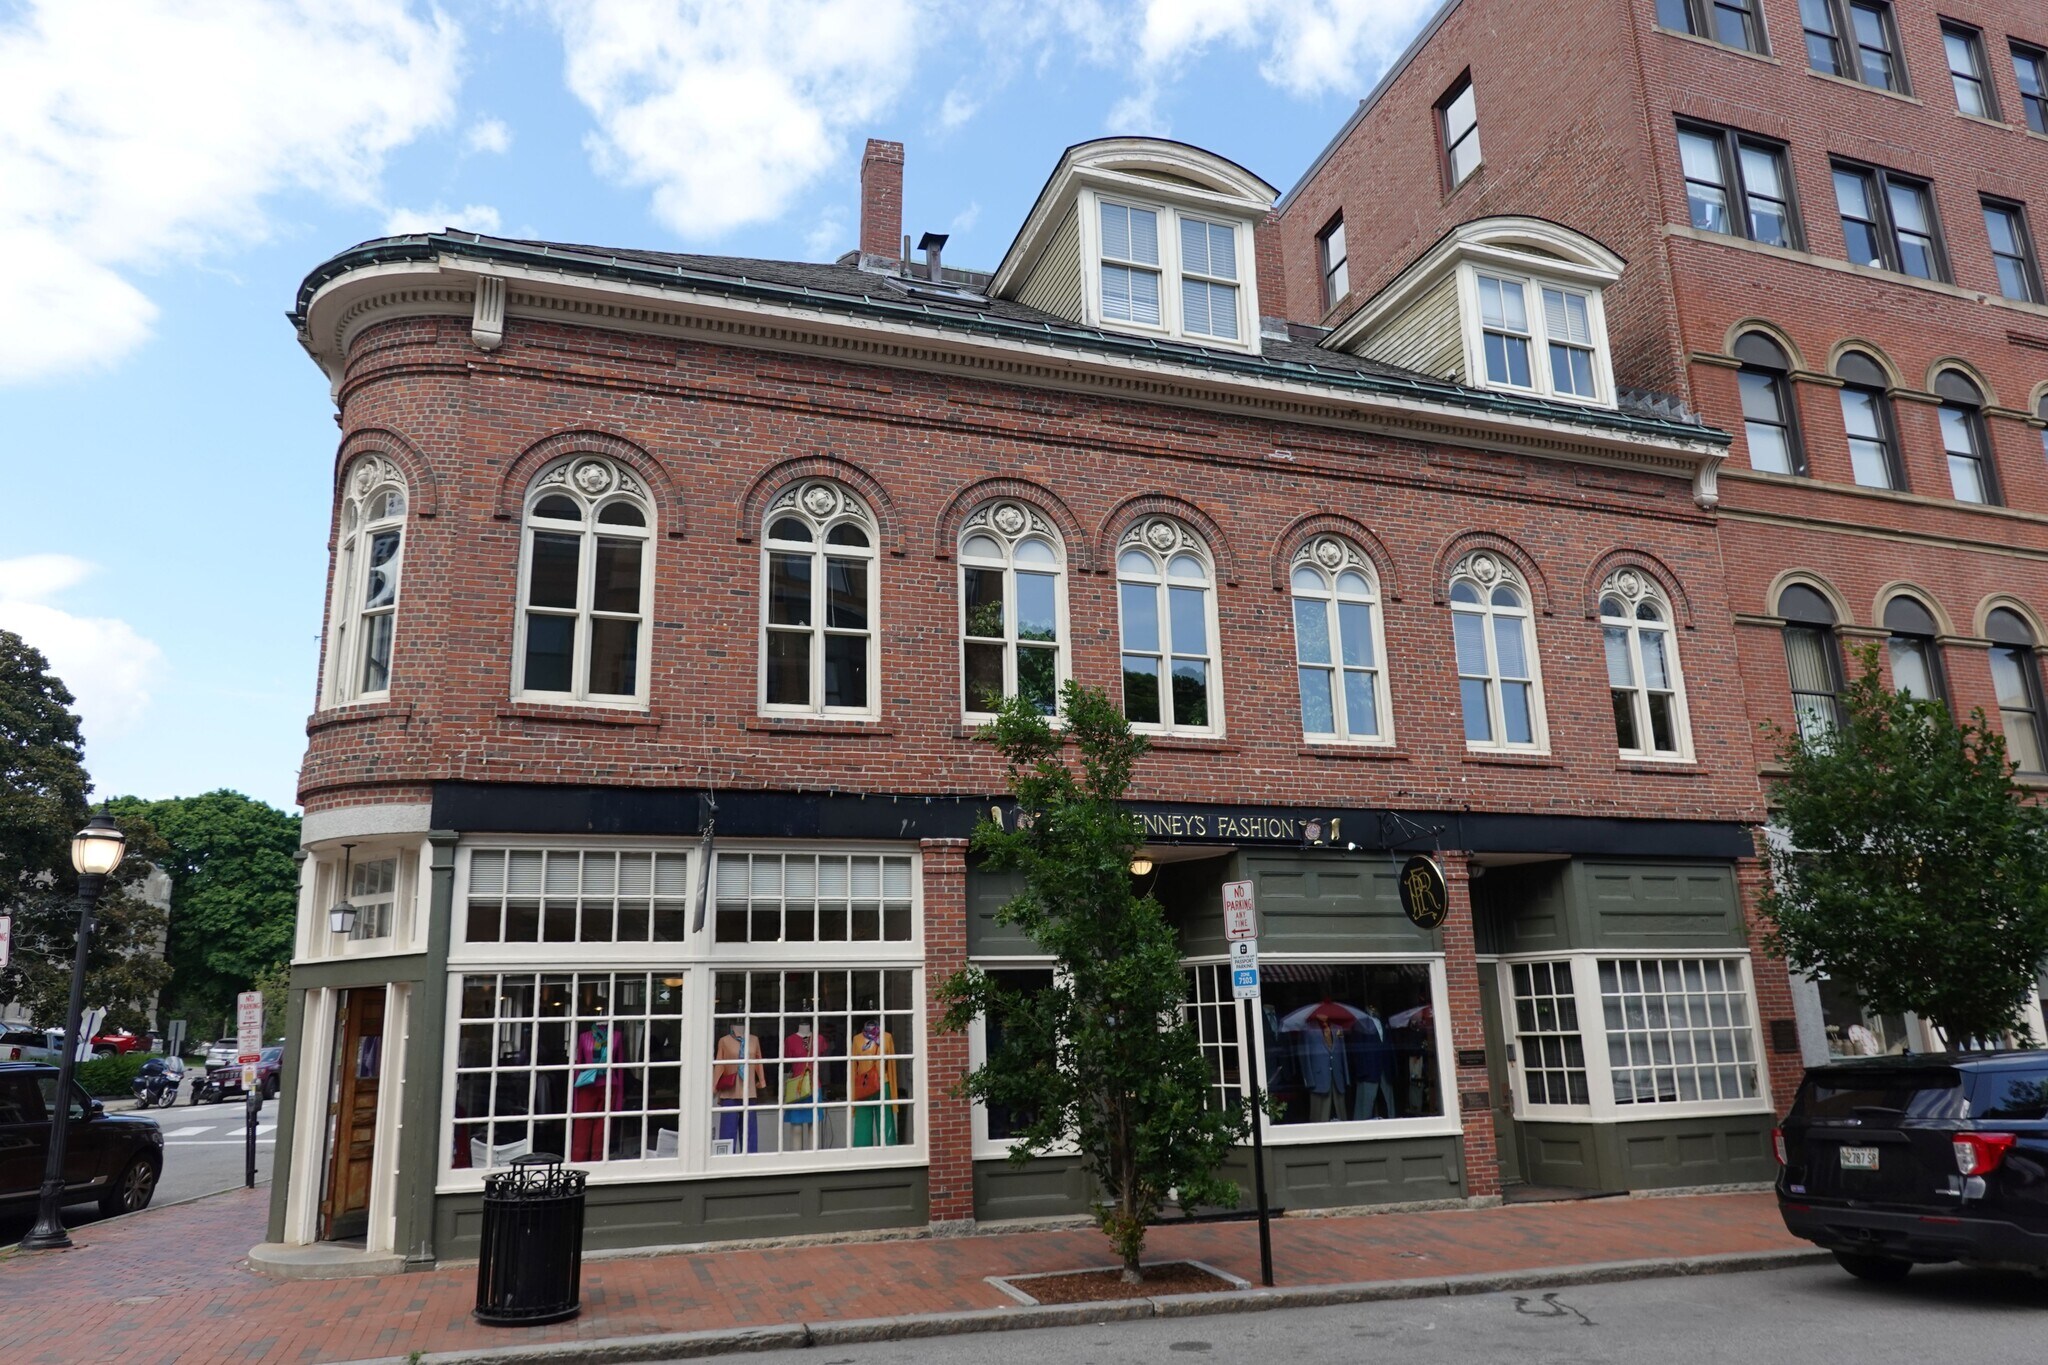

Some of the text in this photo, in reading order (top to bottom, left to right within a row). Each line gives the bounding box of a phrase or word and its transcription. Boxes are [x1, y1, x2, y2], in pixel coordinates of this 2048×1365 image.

[1120, 814, 1294, 839] ENNEY'S FASHION
[1234, 887, 1245, 898] NO
[1226, 899, 1253, 911] PARKING
[1235, 911, 1246, 920] ANY
[1235, 919, 1248, 928] TIME
